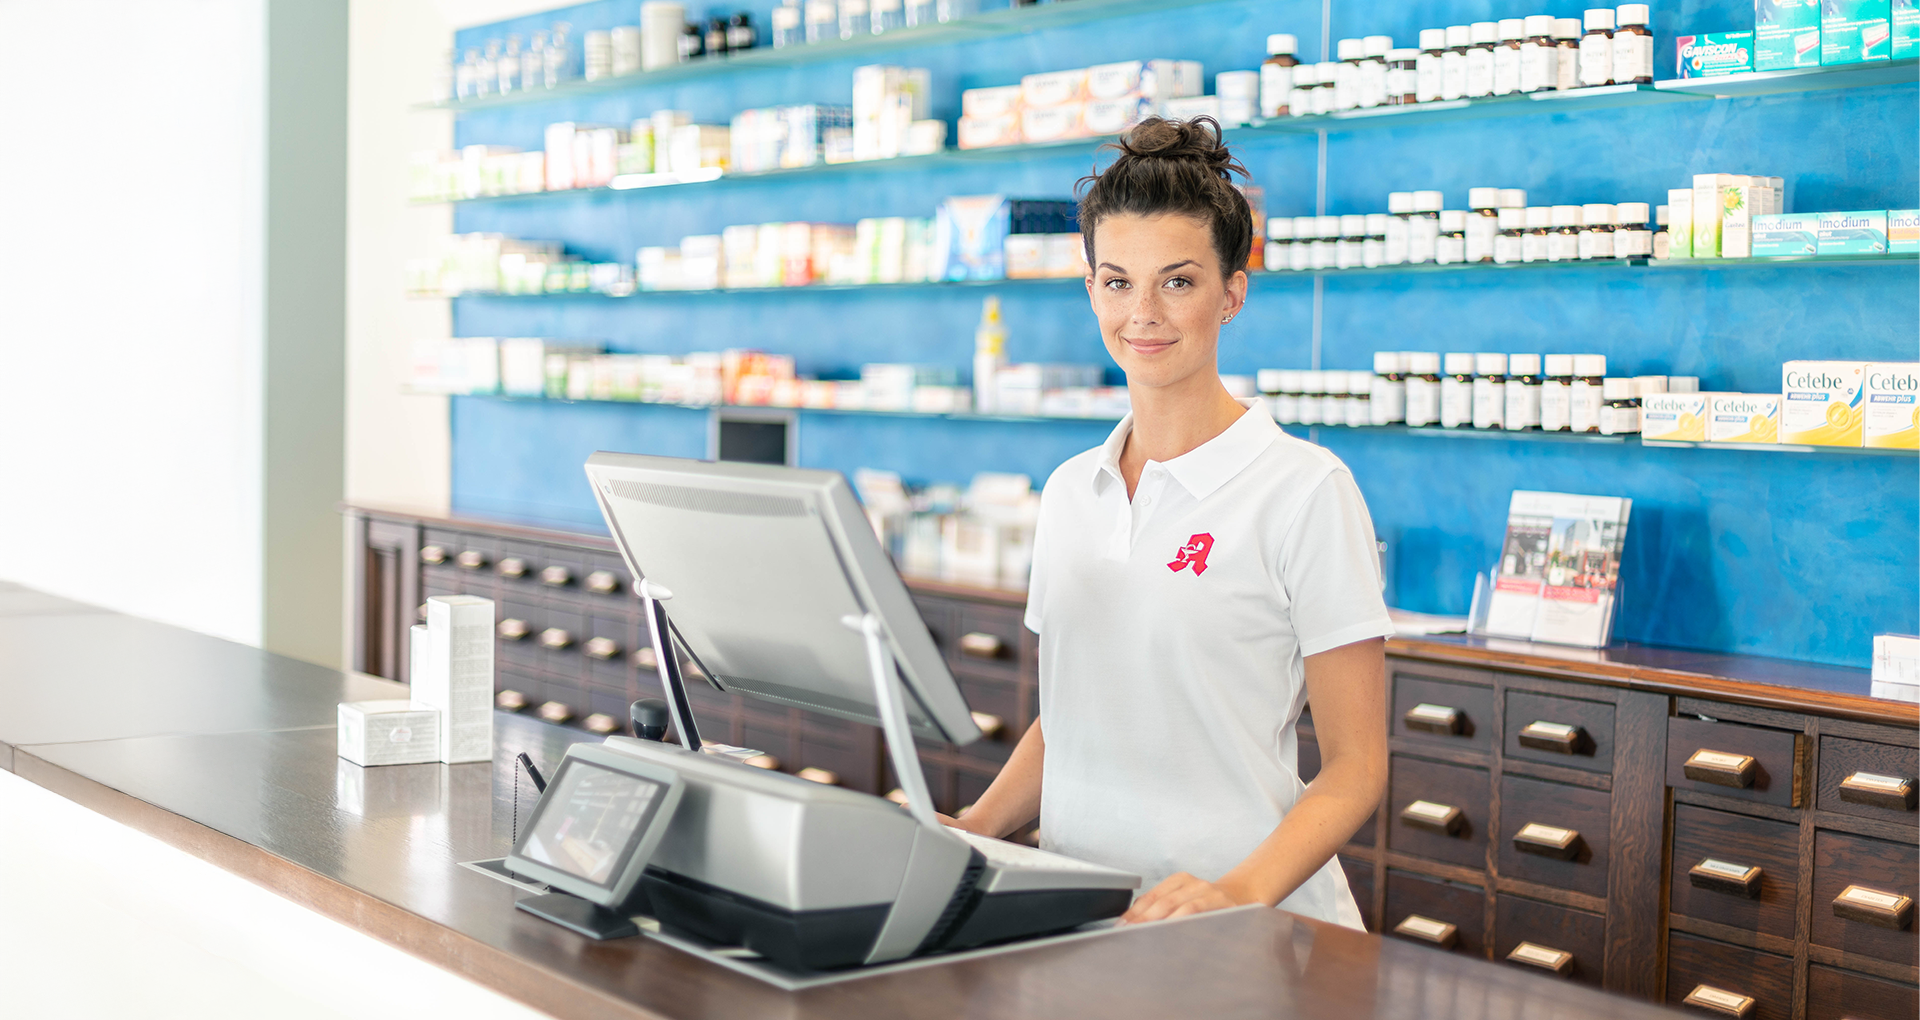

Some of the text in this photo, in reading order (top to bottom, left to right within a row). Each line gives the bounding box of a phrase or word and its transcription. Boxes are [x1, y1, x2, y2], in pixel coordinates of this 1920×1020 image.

[1683, 43, 1738, 59] GAVISCON
[1753, 218, 1803, 231] Imodium
[1819, 216, 1870, 229] Imodium
[1786, 371, 1842, 390] Cetebe
[1869, 373, 1920, 391] Ceteb
[1645, 397, 1686, 411] Cetebe
[1812, 392, 1826, 402] plus
[1896, 393, 1912, 404] plus
[1714, 399, 1757, 413] Cetebe
